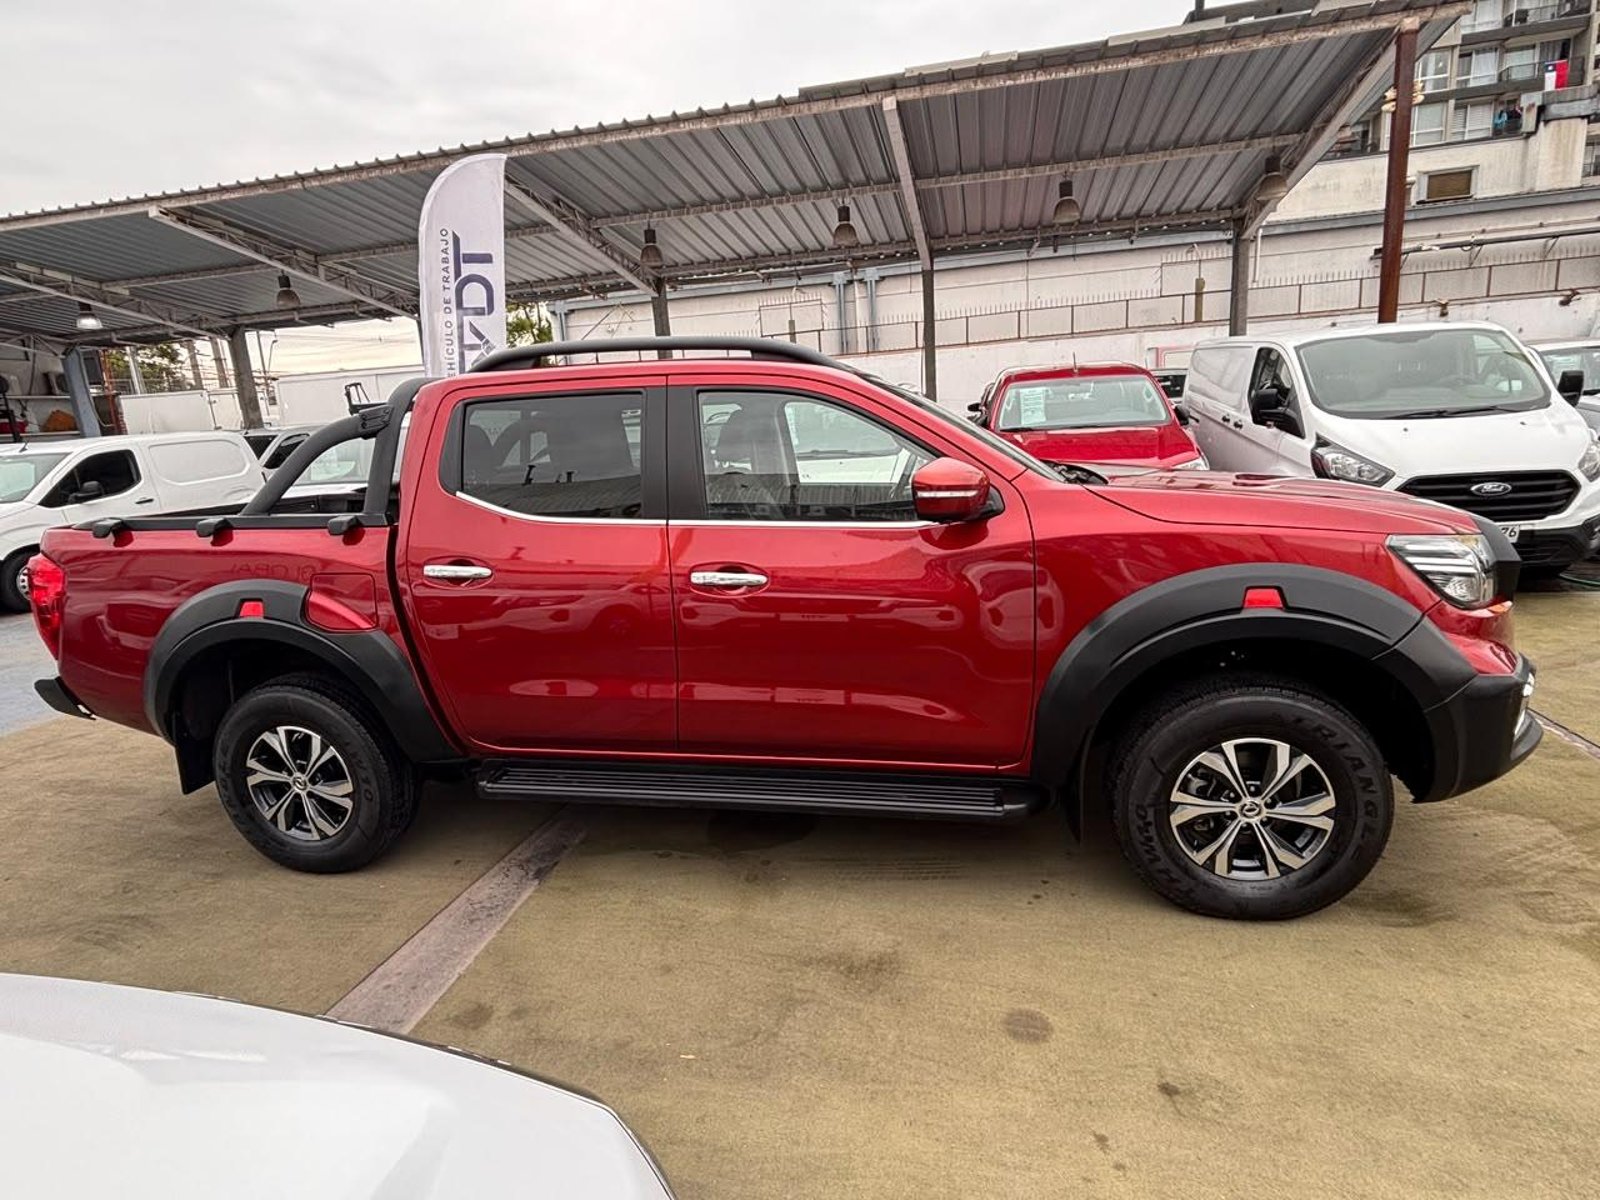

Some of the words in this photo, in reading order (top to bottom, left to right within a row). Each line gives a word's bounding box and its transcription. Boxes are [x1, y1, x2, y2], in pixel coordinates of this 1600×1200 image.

[440, 228, 451, 292] TRABAJO
[444, 295, 452, 314] DE
[444, 320, 456, 378] EHÍCULO
[1287, 716, 1379, 861] TRIANGLE
